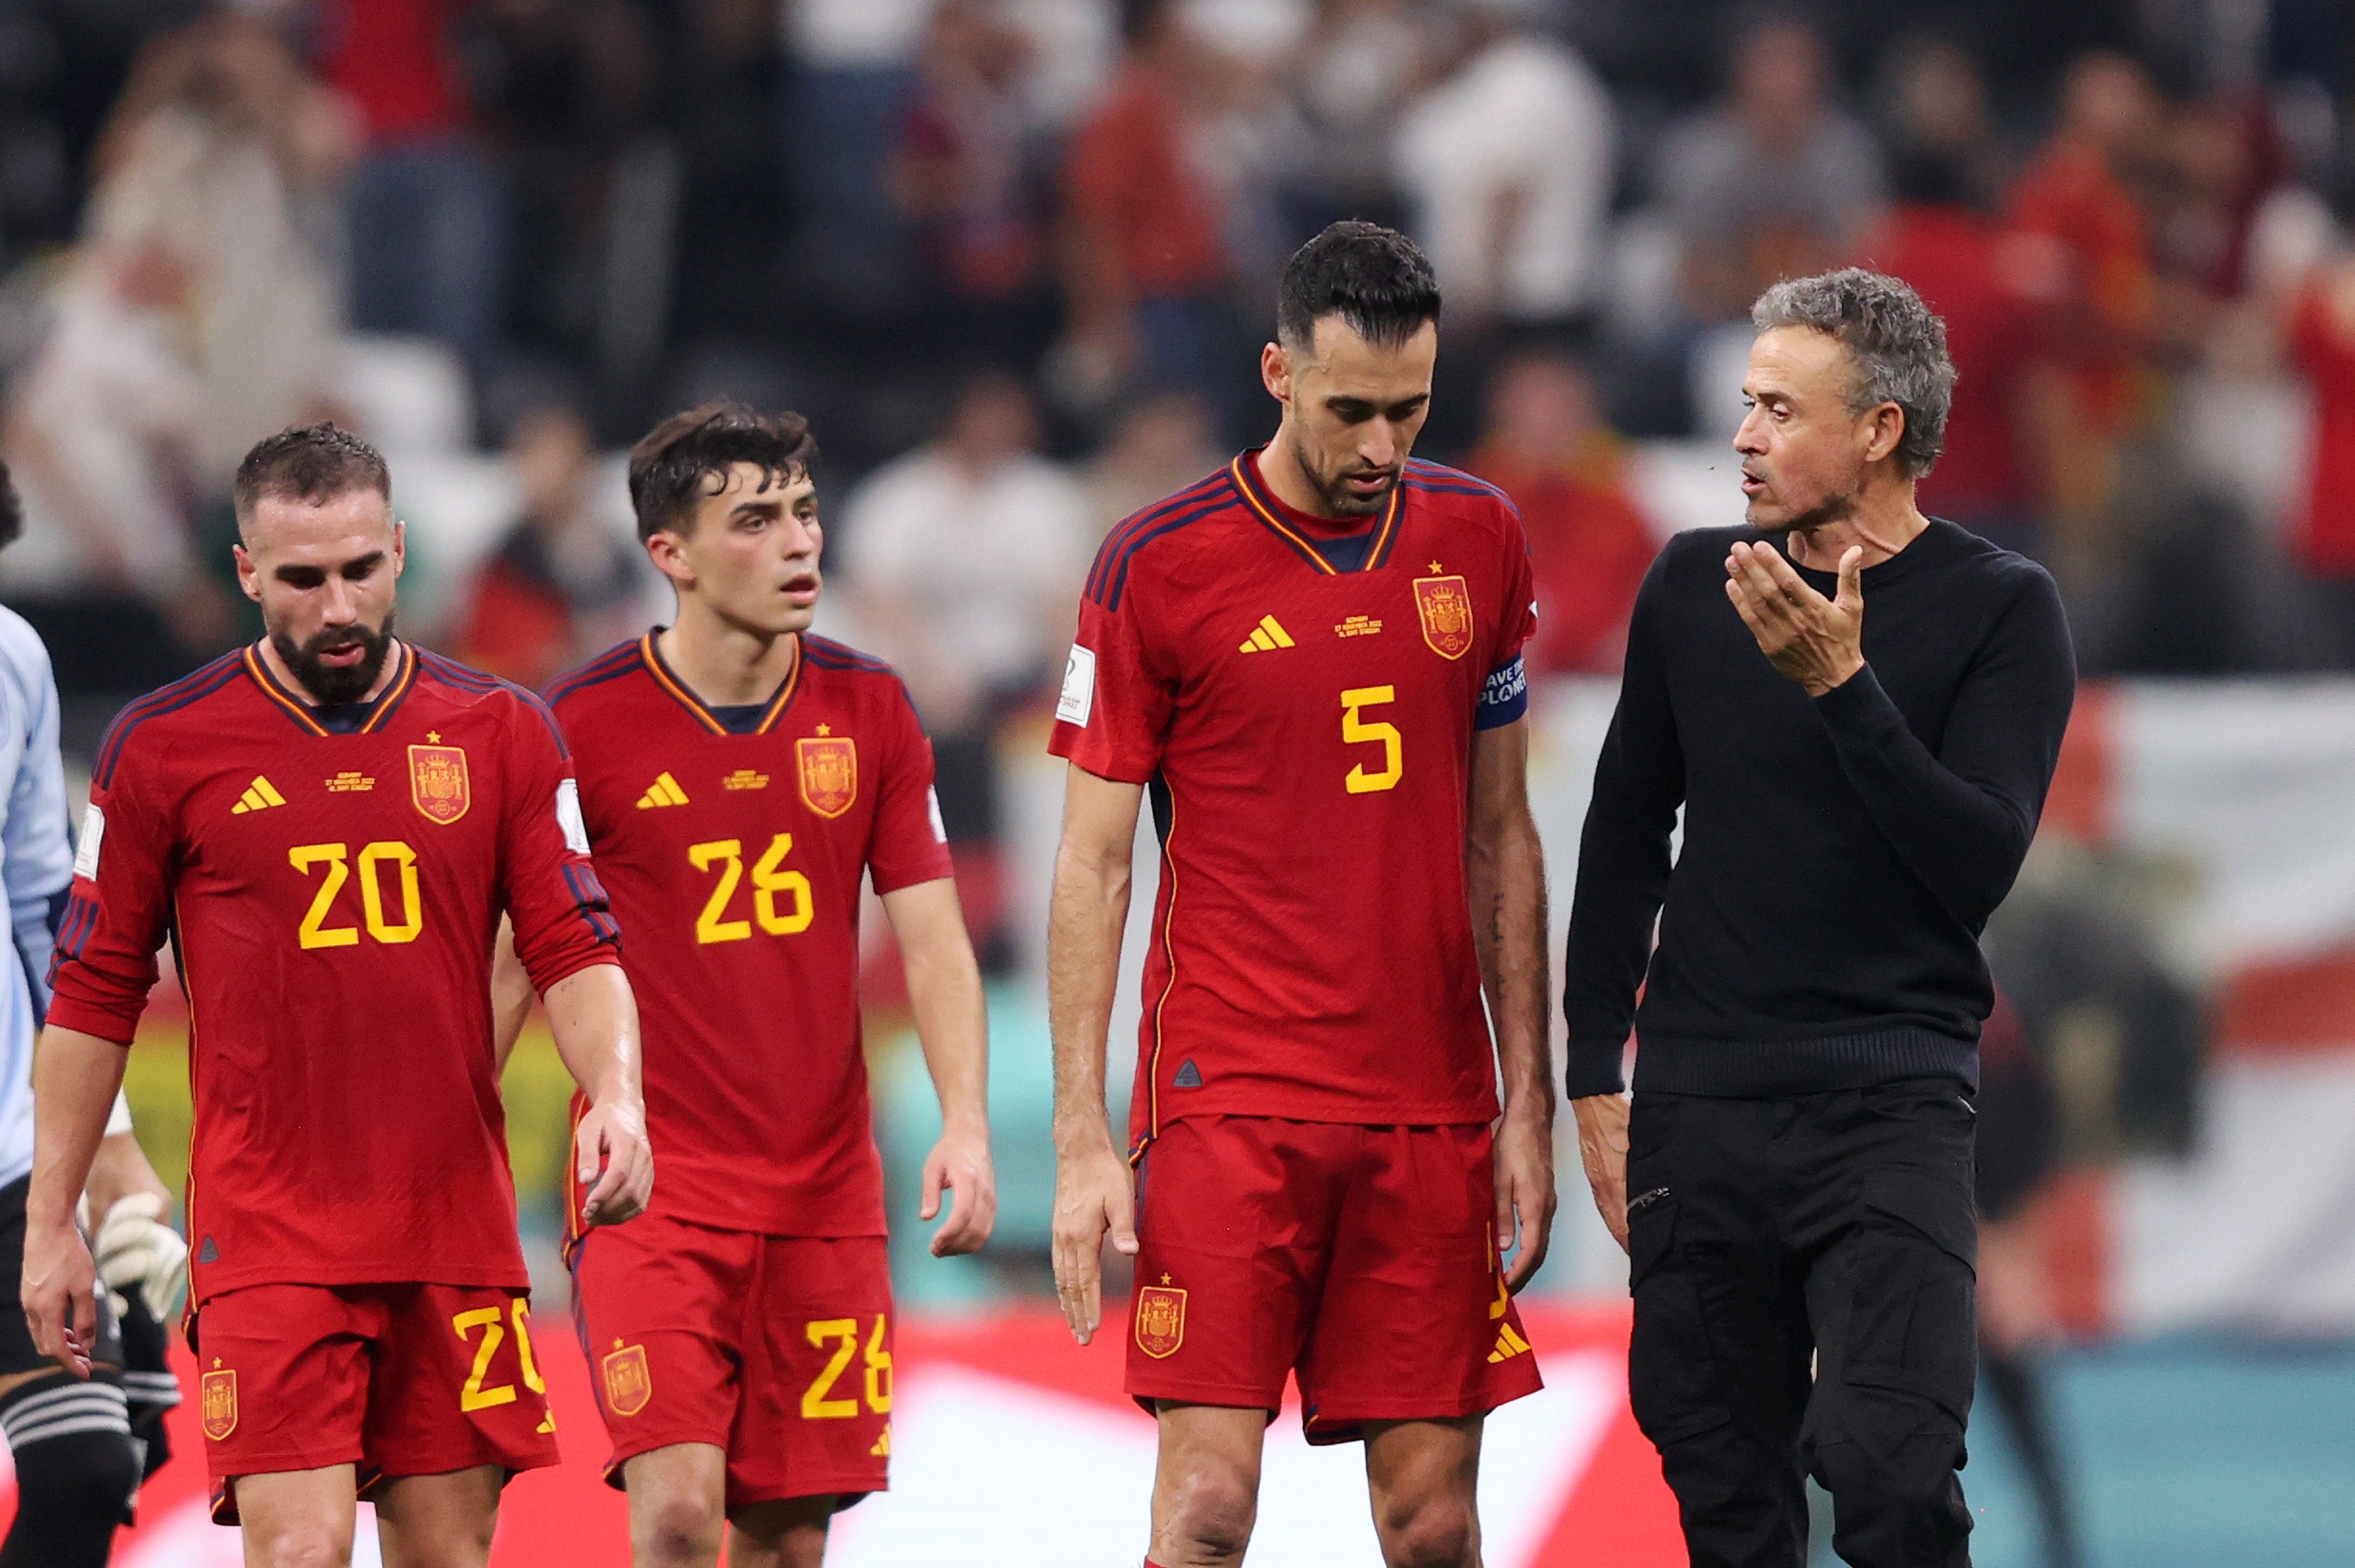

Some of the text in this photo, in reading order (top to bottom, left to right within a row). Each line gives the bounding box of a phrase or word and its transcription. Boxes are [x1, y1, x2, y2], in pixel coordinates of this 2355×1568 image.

[1486, 666, 1513, 687] AVE
[1341, 685, 1403, 793] 5
[289, 841, 422, 949] 20
[688, 833, 813, 943] 26
[801, 1313, 893, 1419] 26
